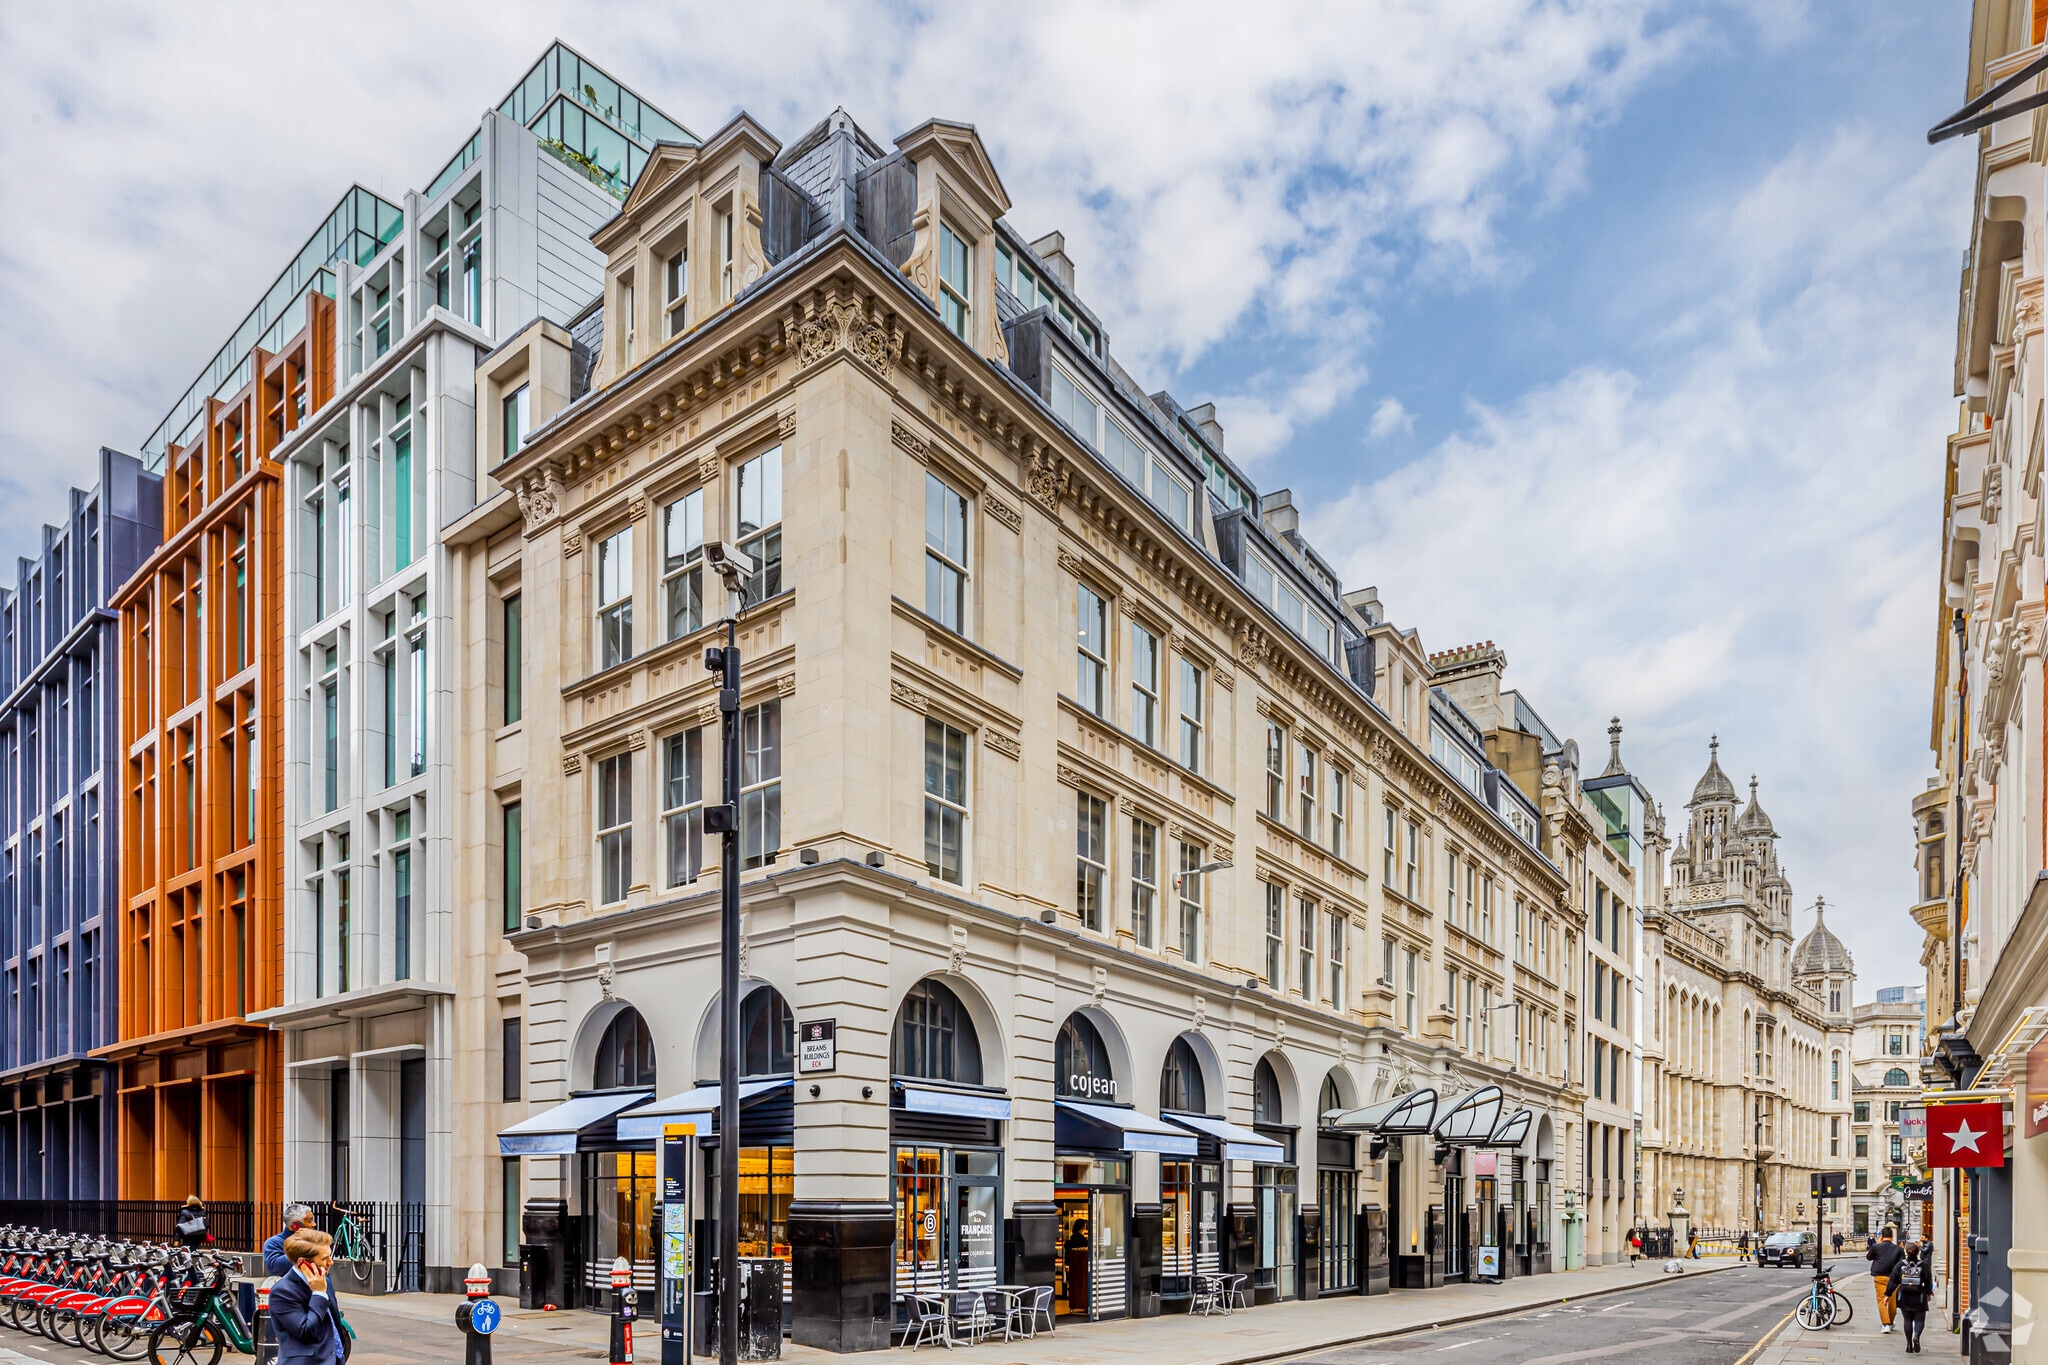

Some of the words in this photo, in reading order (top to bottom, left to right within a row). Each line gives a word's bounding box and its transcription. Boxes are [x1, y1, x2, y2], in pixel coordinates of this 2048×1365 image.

[807, 1044, 827, 1052] BREAMS
[804, 1052, 830, 1061] BUILDINGS
[1071, 1071, 1117, 1098] cojean
[1904, 1118, 1926, 1127] lucky
[961, 1225, 993, 1237] FRANÇAISE
[1434, 1235, 1443, 1249] 28
